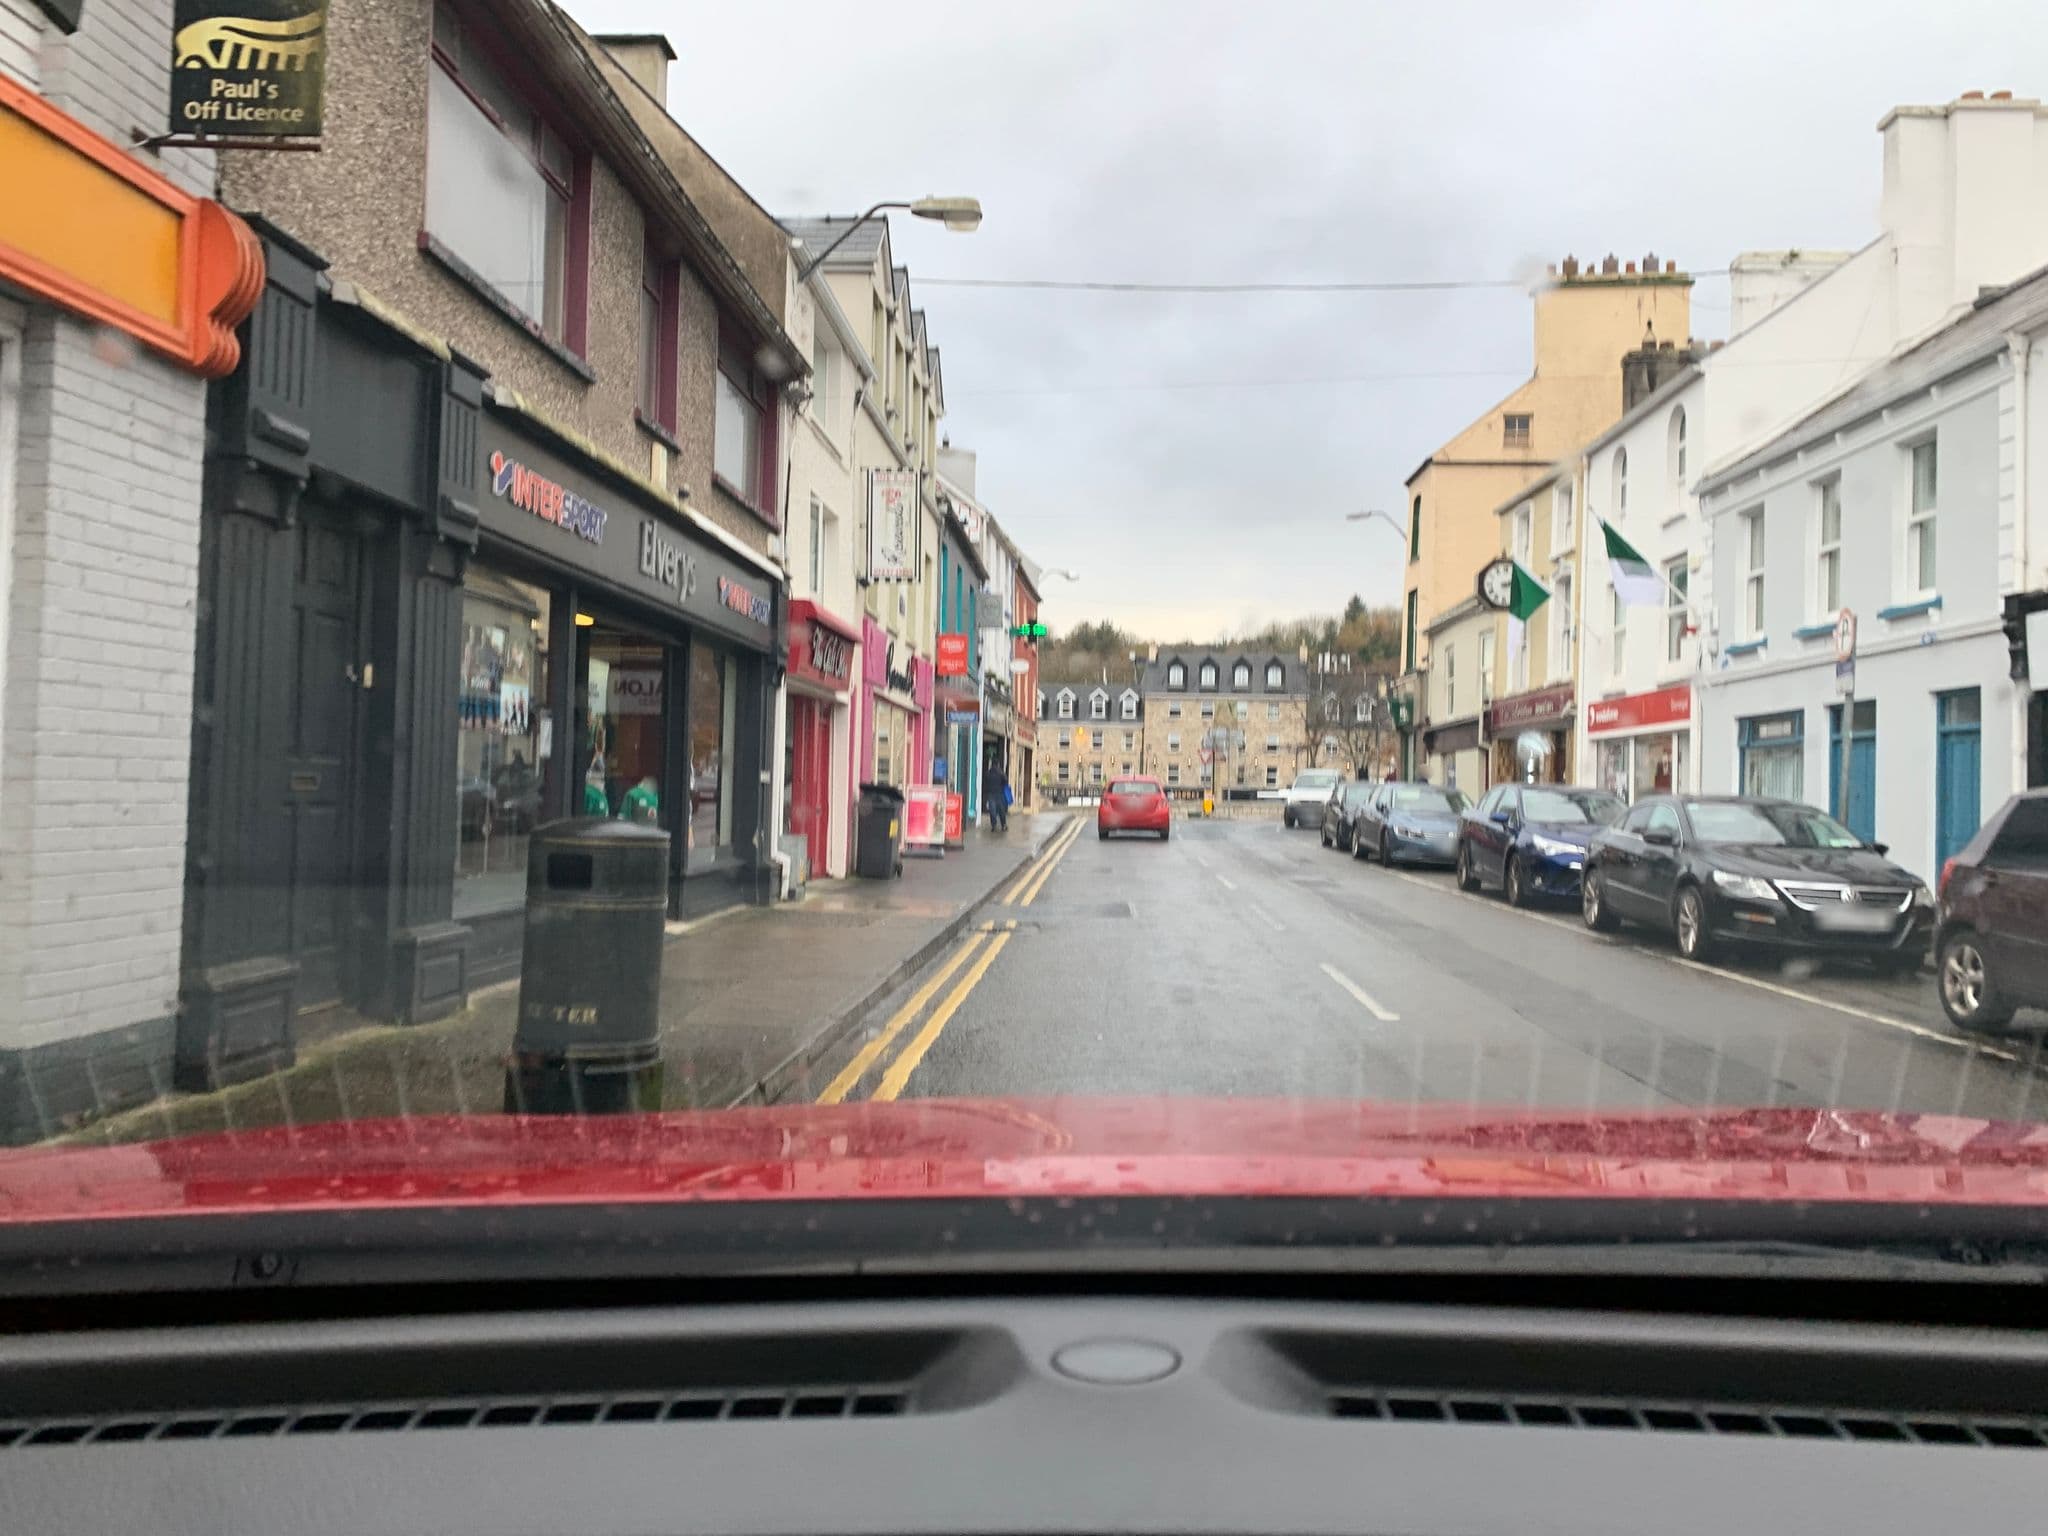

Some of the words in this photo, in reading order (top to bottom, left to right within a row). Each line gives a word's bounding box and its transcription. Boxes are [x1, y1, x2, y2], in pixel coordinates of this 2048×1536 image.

[184, 101, 220, 120] Off
[225, 102, 305, 122] Licence
[210, 78, 279, 99] Paul's
[511, 462, 608, 544] INTERSPORT
[640, 520, 697, 602] Elverys
